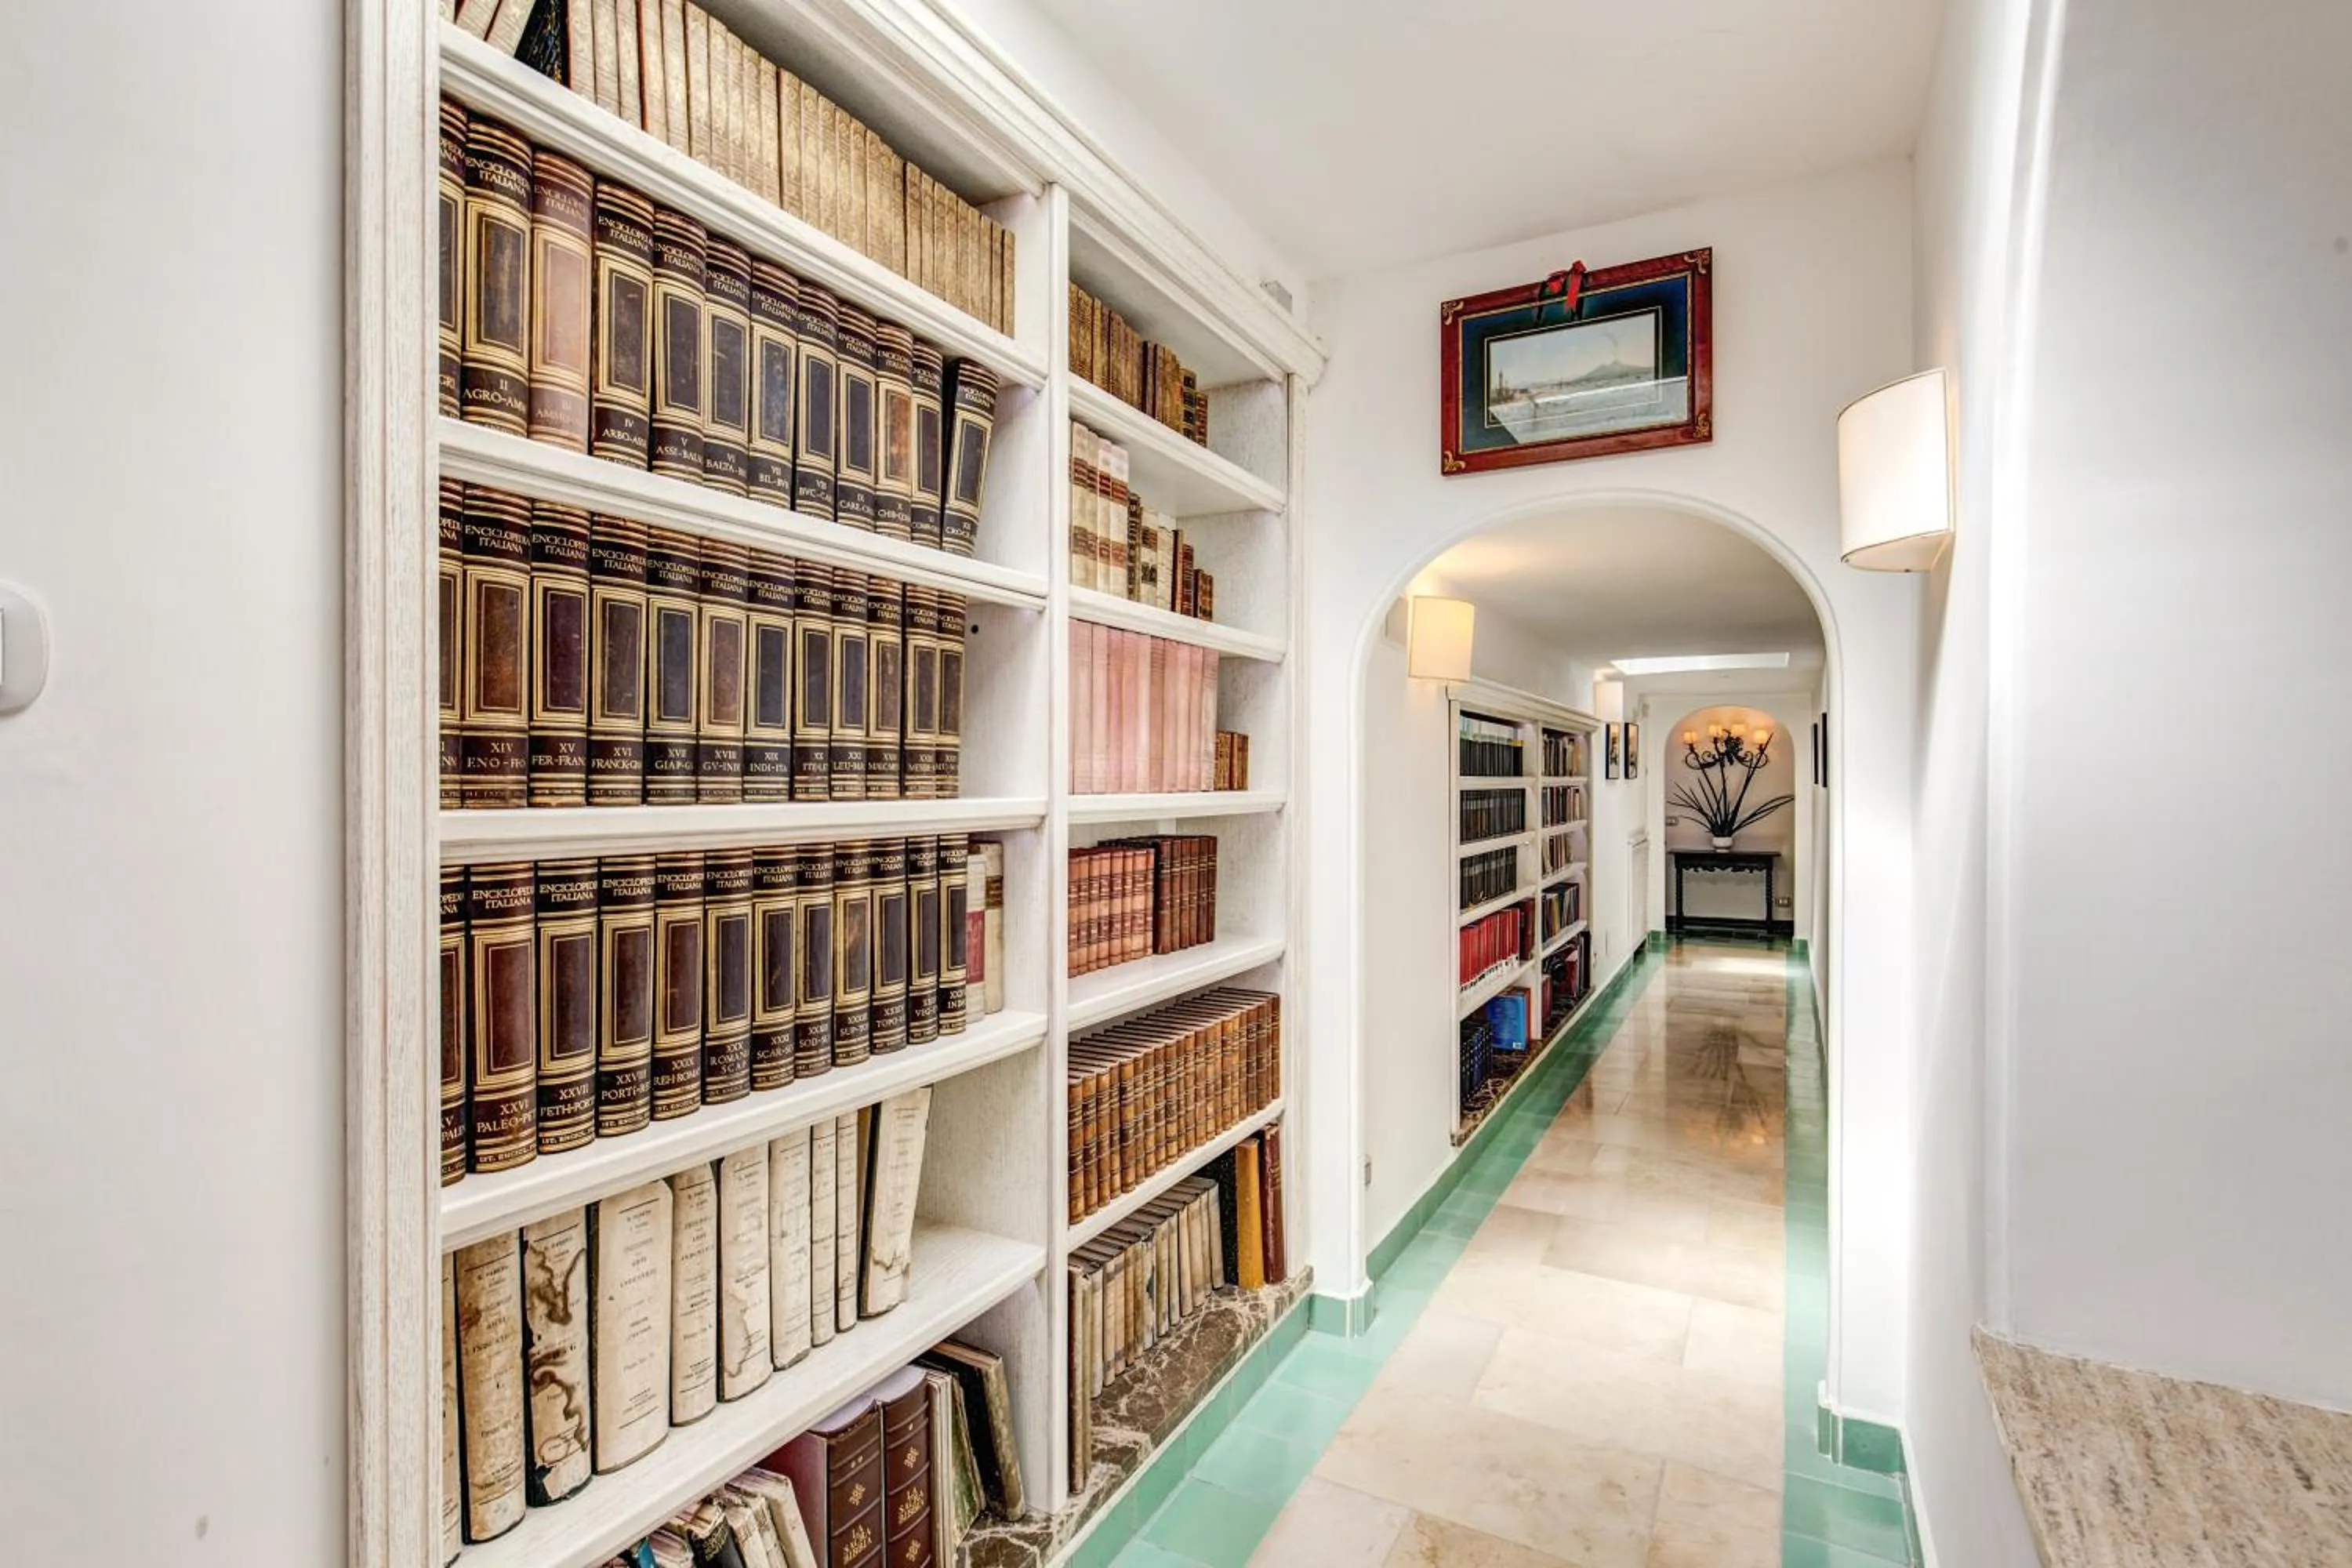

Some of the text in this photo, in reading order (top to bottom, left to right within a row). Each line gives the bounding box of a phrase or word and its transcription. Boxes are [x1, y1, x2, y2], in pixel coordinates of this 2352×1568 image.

[479, 170, 526, 198] ITALIANA
[499, 378, 507, 391] II
[624, 418, 634, 428] IV
[681, 437, 688, 446] V
[479, 537, 523, 554] ITALIANA
[545, 544, 587, 561] ITALIANA
[604, 559, 644, 575] ITALIANA
[659, 569, 693, 583] ITALIANA
[490, 742, 514, 753] XIV
[558, 742, 576, 753] XV
[613, 747, 633, 757] XVI
[613, 884, 652, 897] ITALIANA
[666, 880, 702, 892] ITALIANA
[484, 895, 532, 909] ITALIANA
[551, 891, 594, 903] ITALIANA
[725, 1040, 745, 1054] XXX
[558, 1085, 589, 1101] XXVII
[500, 1099, 529, 1116] XXVI
